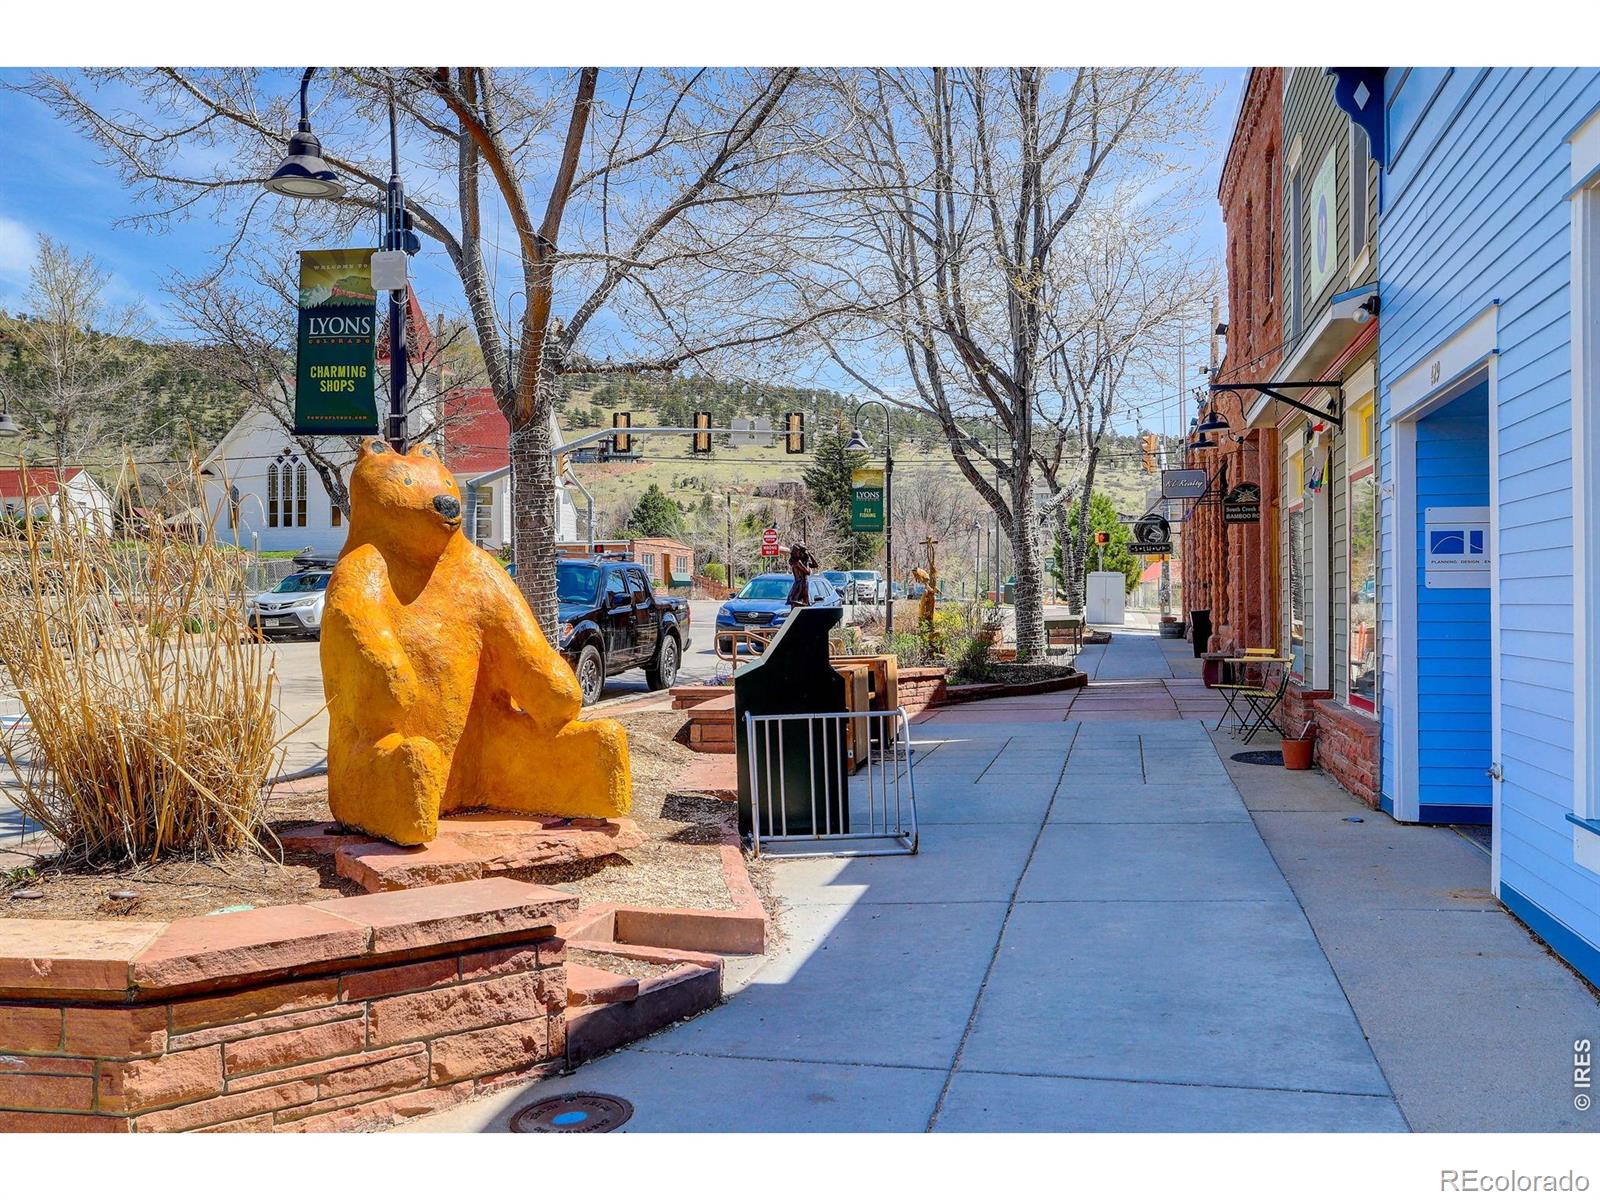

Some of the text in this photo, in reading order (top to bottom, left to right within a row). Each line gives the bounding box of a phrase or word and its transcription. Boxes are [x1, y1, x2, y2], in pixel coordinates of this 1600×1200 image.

[309, 316, 371, 335] LYONS
[310, 365, 367, 378] CHARMING
[320, 379, 355, 392] SHOPS
[1179, 479, 1203, 489] Realty
[856, 491, 880, 499] LYONS
